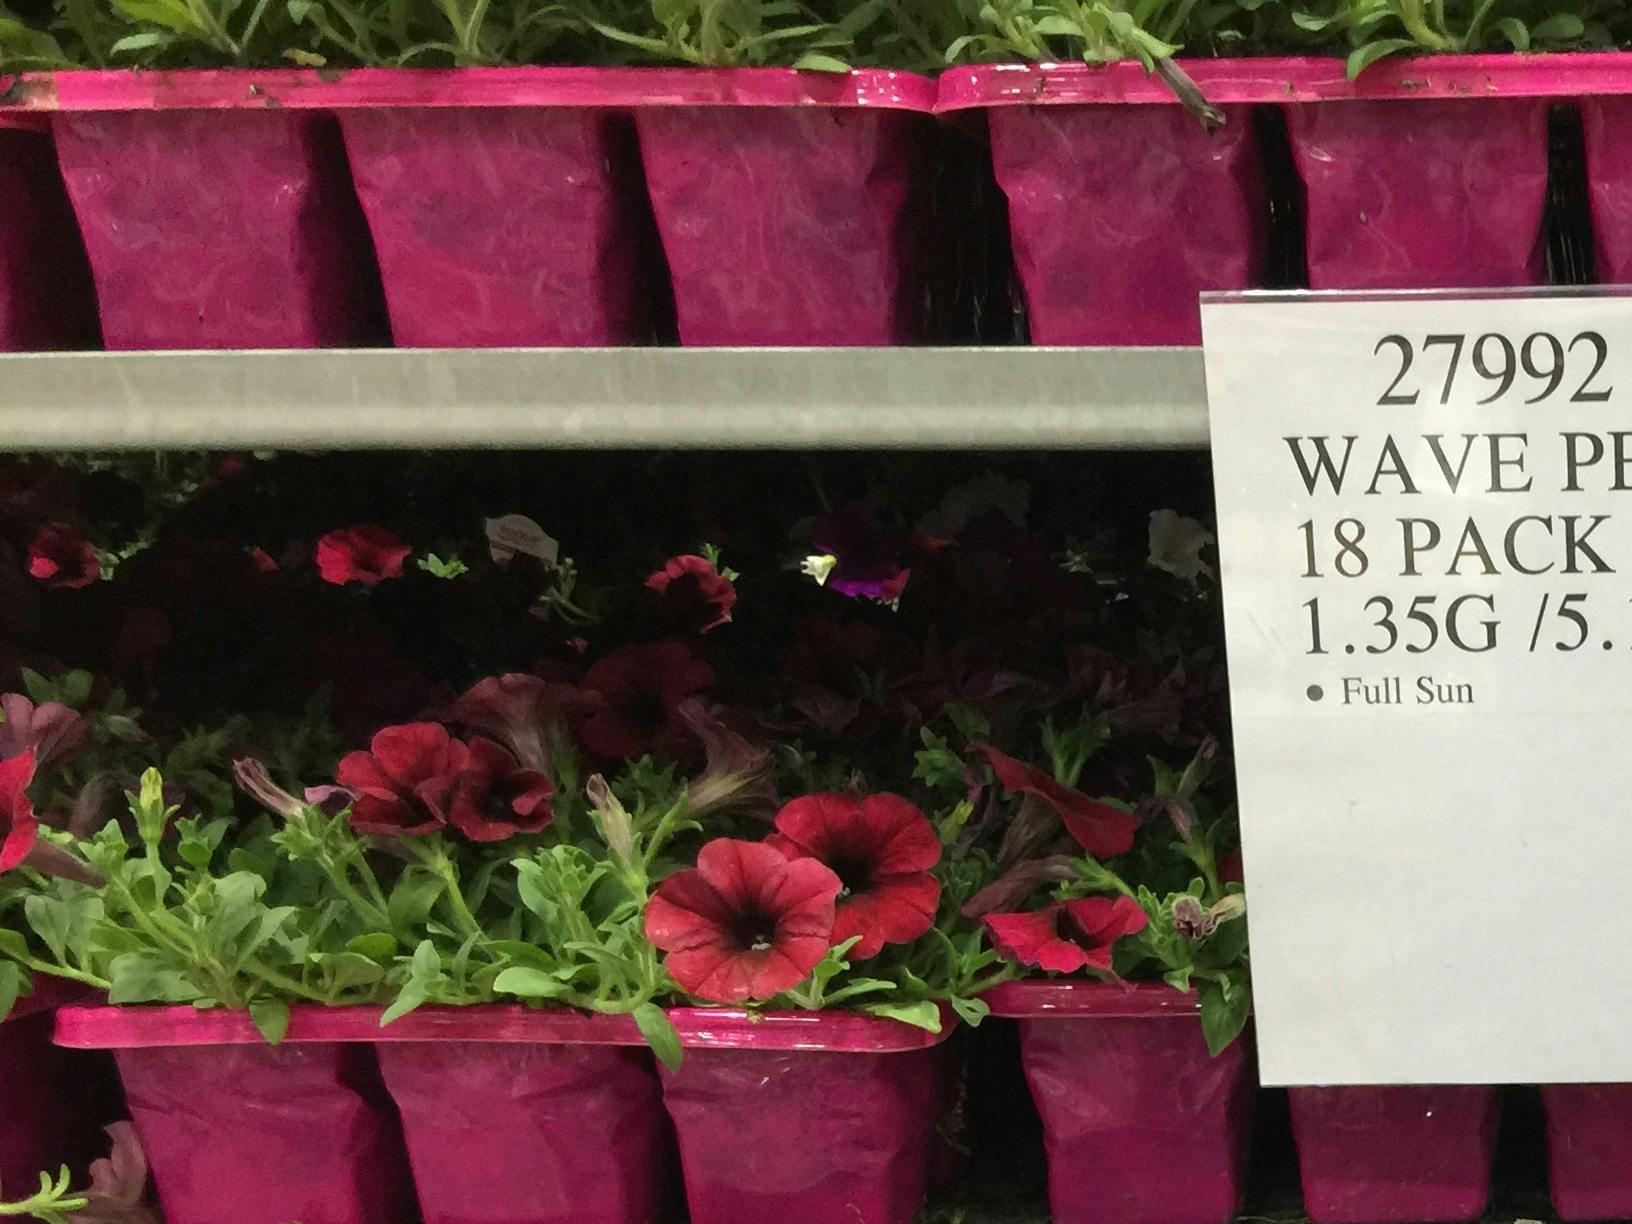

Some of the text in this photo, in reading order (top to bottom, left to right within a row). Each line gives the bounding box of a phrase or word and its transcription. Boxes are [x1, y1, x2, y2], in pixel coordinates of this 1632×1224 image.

[1373, 331, 1614, 406] 27992
[1282, 432, 1534, 497] WAVE
[1297, 514, 1617, 578] 18 PACK
[1302, 592, 1502, 655] 1.35G
[1340, 674, 1475, 705] Full Sun
